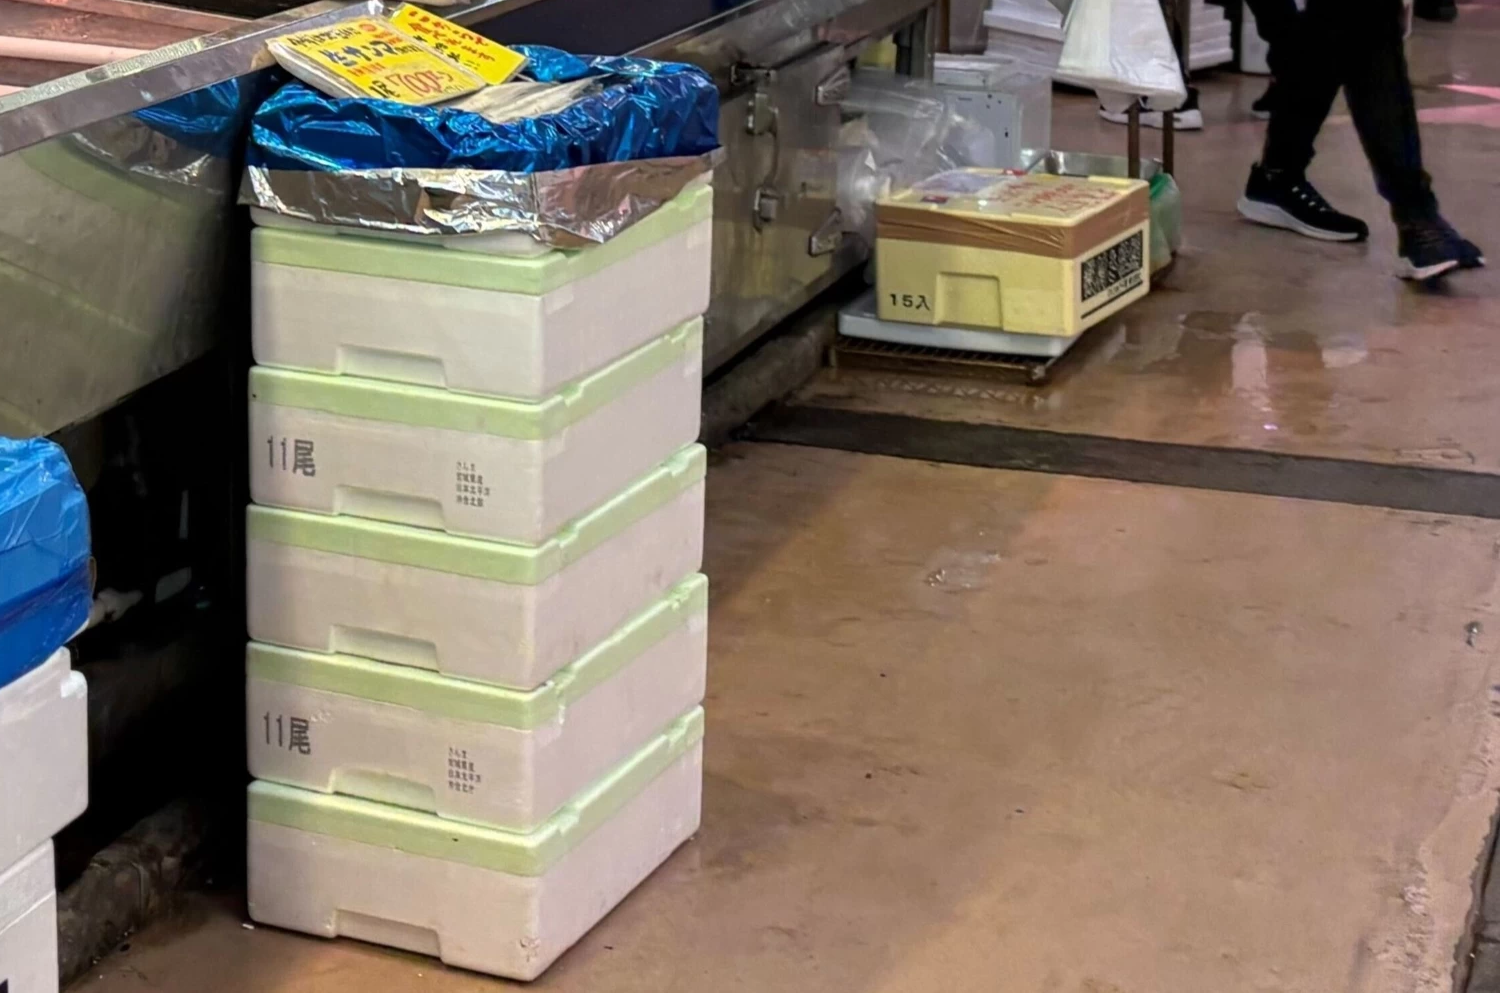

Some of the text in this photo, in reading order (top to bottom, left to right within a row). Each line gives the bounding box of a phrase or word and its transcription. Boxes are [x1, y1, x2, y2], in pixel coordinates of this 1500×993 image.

[889, 292, 932, 312] 15入
[267, 435, 316, 478] 11尾
[263, 711, 312, 756] 11尾
